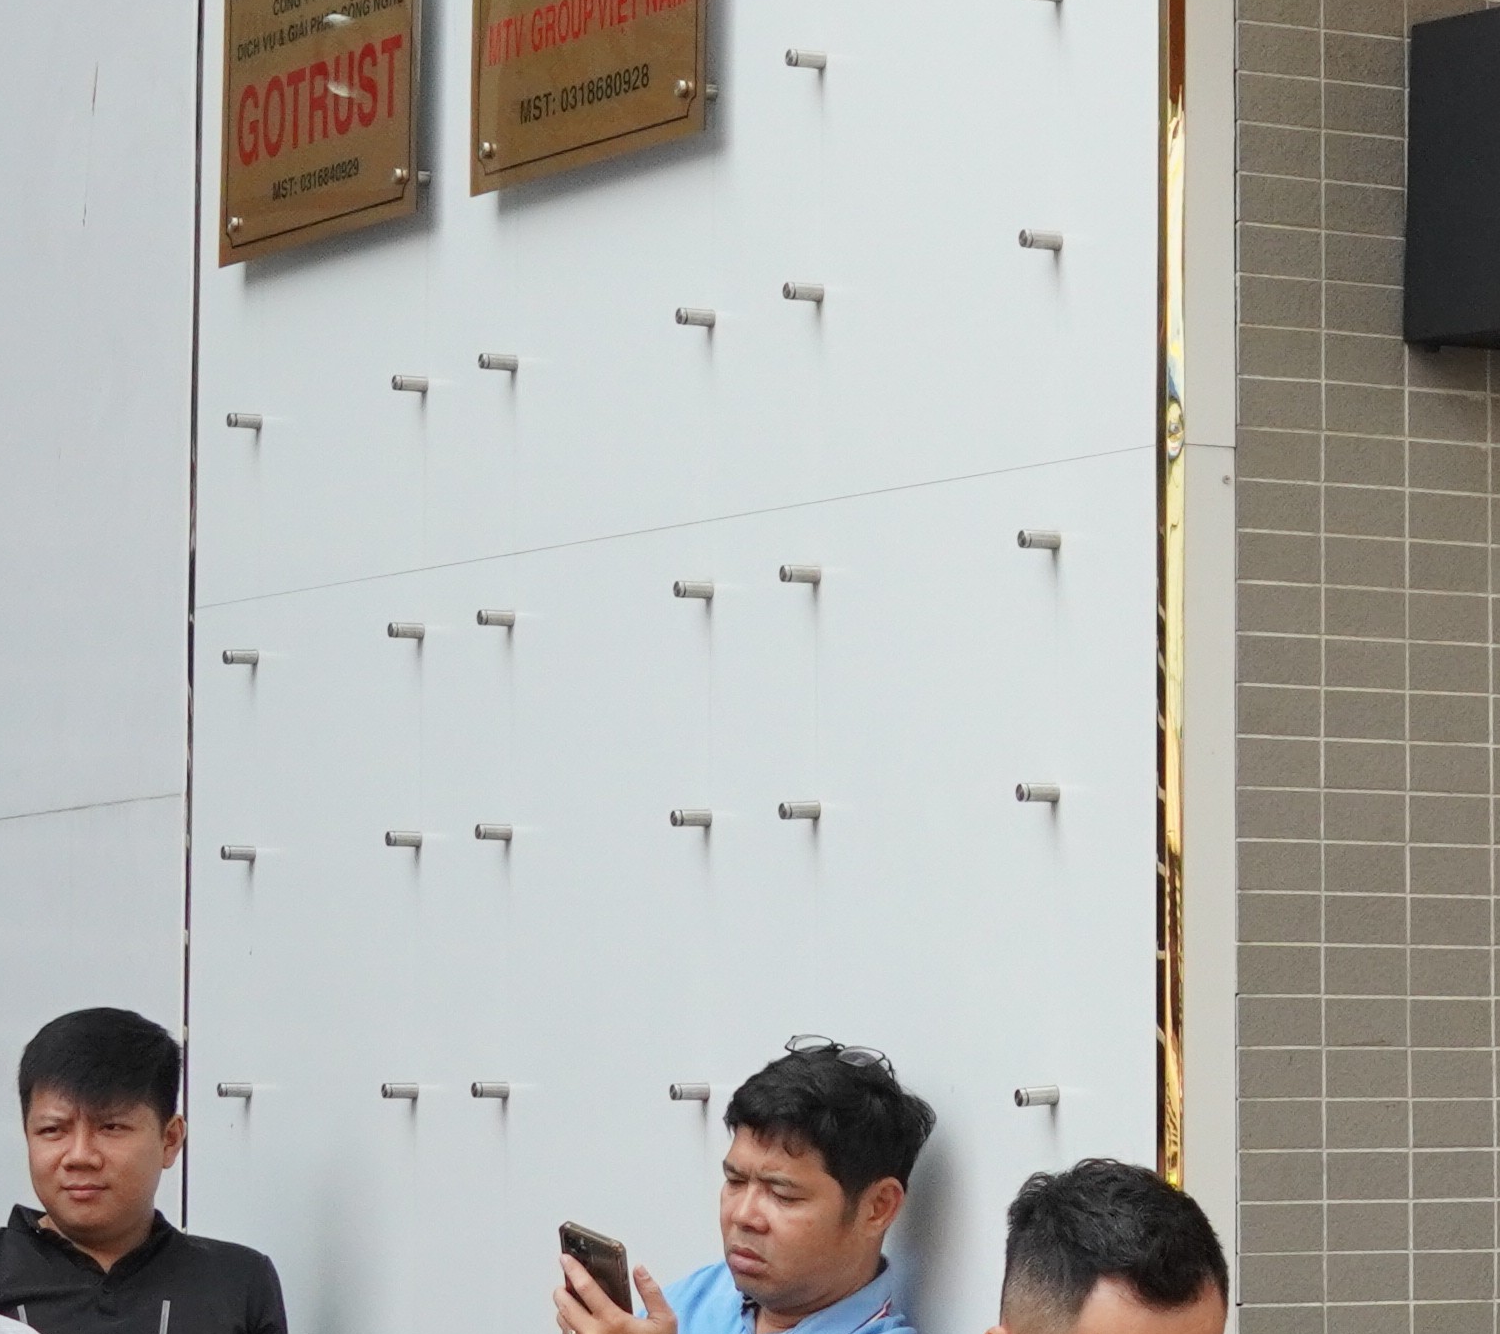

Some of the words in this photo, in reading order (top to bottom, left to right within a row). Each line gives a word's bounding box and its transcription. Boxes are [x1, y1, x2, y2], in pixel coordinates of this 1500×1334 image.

[487, 12, 524, 67] MTV
[237, 34, 403, 166] GOTRUST
[520, 91, 556, 125] MST:
[560, 63, 650, 113] 0318680928
[272, 175, 298, 202] MST:
